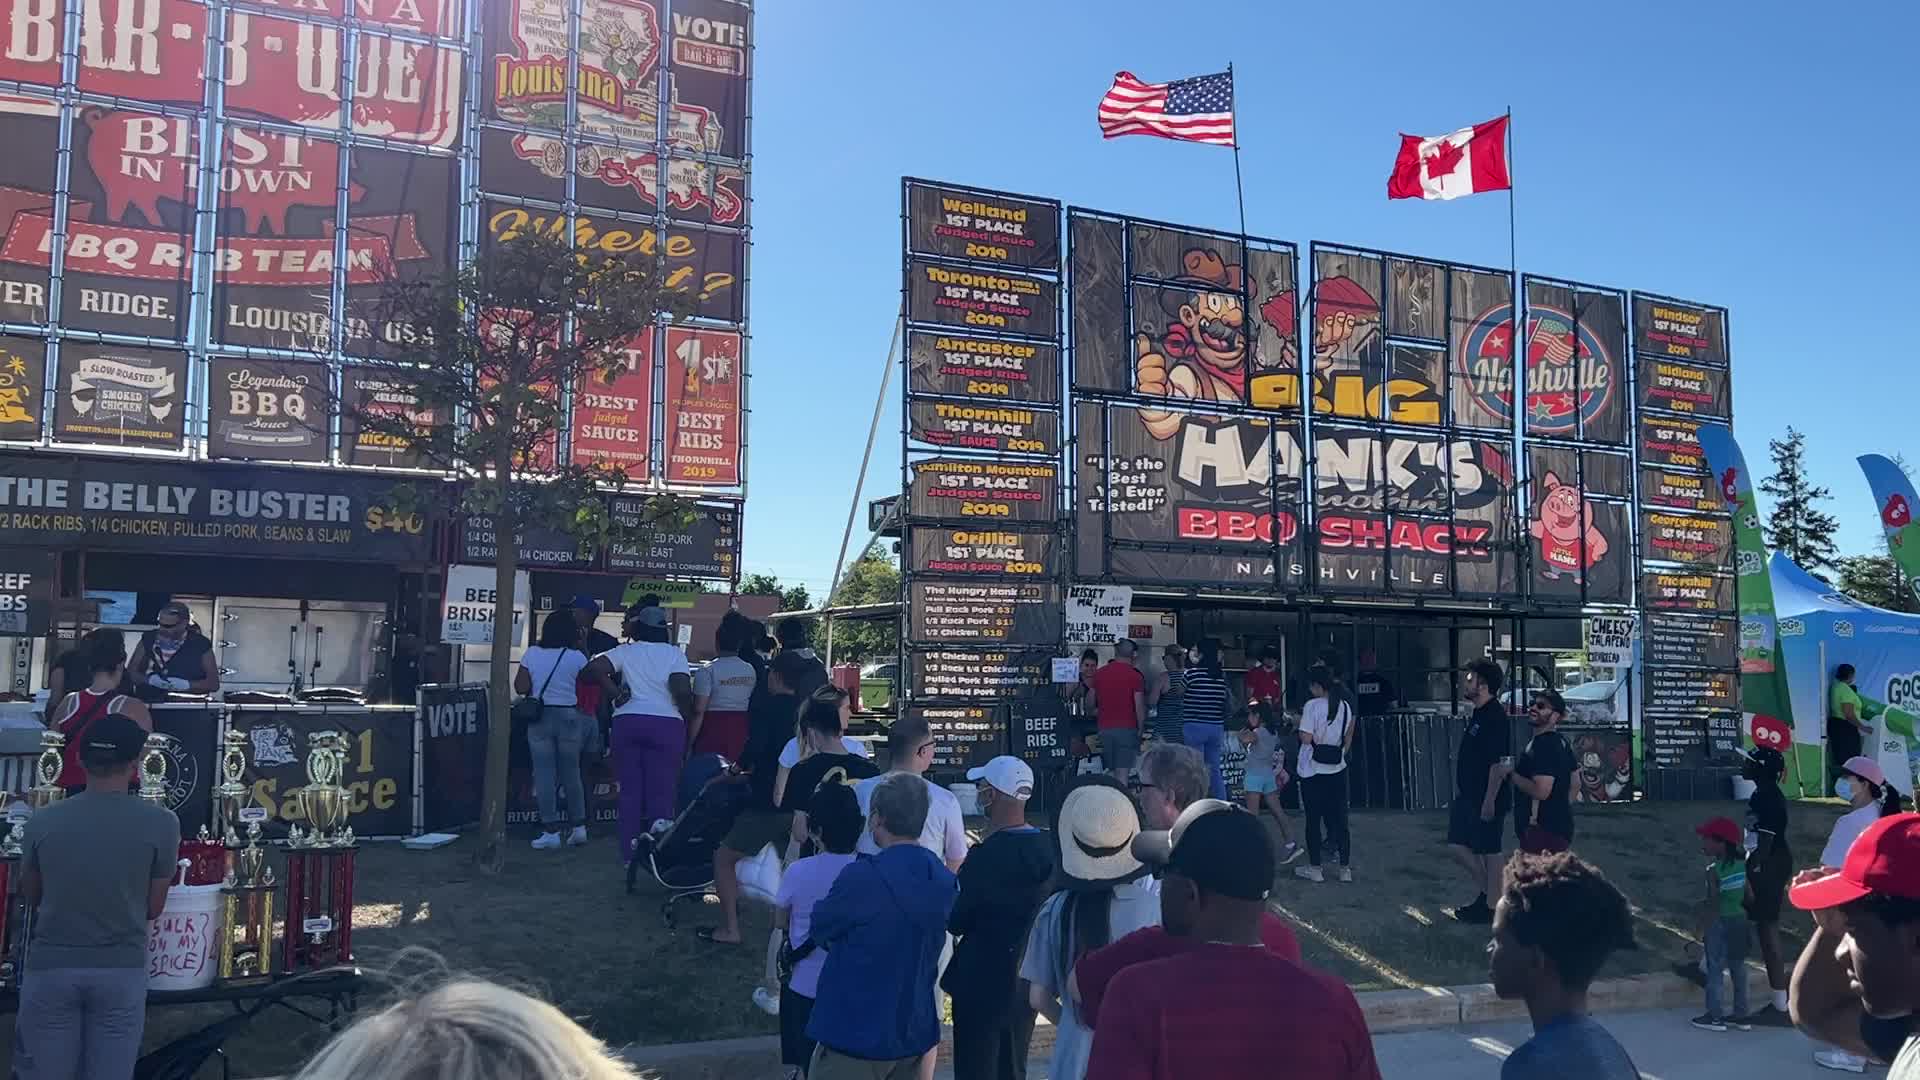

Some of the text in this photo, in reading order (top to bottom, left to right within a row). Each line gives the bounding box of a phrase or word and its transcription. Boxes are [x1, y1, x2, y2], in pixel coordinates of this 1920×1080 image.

[672, 13, 745, 47] VOTE
[120, 155, 164, 184] IN
[943, 198, 1027, 222] Welland
[945, 214, 1024, 236] 1ST PLACE
[149, 241, 243, 273] RB
[965, 243, 1008, 260] 2019
[927, 267, 1010, 291] Toronto
[944, 286, 1020, 306] 1ST PLACE
[79, 288, 176, 321] RIDGE,
[965, 311, 1006, 328] 2019
[1653, 307, 1701, 324] Windsor
[1654, 320, 1698, 335] 1ST PLACE
[936, 338, 1036, 359] Ancaster
[944, 352, 1024, 371] 1ST PLACE
[90, 364, 155, 384] SLOW ROASTED
[1474, 356, 1608, 396] Nashville
[1657, 364, 1704, 380] Midland
[228, 369, 308, 392] Legendary
[967, 380, 1009, 396] 2019
[1658, 376, 1701, 391] 1ST PLACE
[102, 390, 143, 401] SMOKED
[584, 394, 639, 411] BEST
[1250, 374, 1440, 426] BIG
[679, 412, 726, 431] BEST
[936, 404, 1032, 425] Thornhill
[581, 424, 640, 442] SAUCE
[944, 420, 1023, 437] 1ST PLACE
[1656, 429, 1674, 440] 1ST
[680, 431, 724, 450] RIBS
[1007, 438, 1045, 452] 2019
[671, 454, 732, 466] THORNHILL
[1135, 458, 1164, 470] the
[1178, 422, 1482, 497] HANK'S
[682, 465, 716, 478] 2019
[986, 465, 1054, 477] Mountain
[1110, 472, 1147, 484] Best
[940, 475, 1030, 491] 1ST PLACE
[0, 477, 350, 522] THE BELLY BUSTER
[1126, 486, 1165, 498] Ever
[1660, 485, 1704, 498] 1ST PLACE
[961, 502, 1009, 517] 2019
[13, 513, 51, 530] RACK
[90, 518, 108, 533] 1/4
[173, 521, 221, 537] PULLED
[264, 526, 304, 541] BEANS
[306, 527, 315, 541] &
[318, 529, 351, 543] SLAW
[1178, 508, 1489, 558] BBQ SHACK
[1661, 528, 1703, 541] 1ST PLACE
[952, 532, 1019, 546] Orillia
[533, 550, 573, 562] CHICKEN
[945, 547, 1025, 562] 1ST PLACE
[1005, 562, 1043, 574] 2019
[1236, 562, 1445, 586] NASHVILLE
[630, 581, 697, 593] CASH ONLY
[925, 586, 1018, 597] The Hungry Hank
[1662, 587, 1707, 599] 1ST PLACE
[465, 588, 498, 603] BEE
[1099, 606, 1125, 616] CHEESE
[1592, 618, 1634, 636] CHEESY
[942, 653, 980, 661] Chicken
[925, 675, 1029, 684] Pulled Pork Sandwich
[941, 688, 997, 696] Pulled Pork
[429, 703, 477, 738] VOTE
[922, 709, 966, 718] Sausage
[955, 722, 990, 730] Cheese
[1025, 717, 1057, 731] BEEF
[947, 734, 978, 742] Bread
[1027, 733, 1057, 747] RIBS
[252, 777, 398, 823] Sace
[178, 935, 200, 951] MY
[150, 952, 198, 975] SPICE
